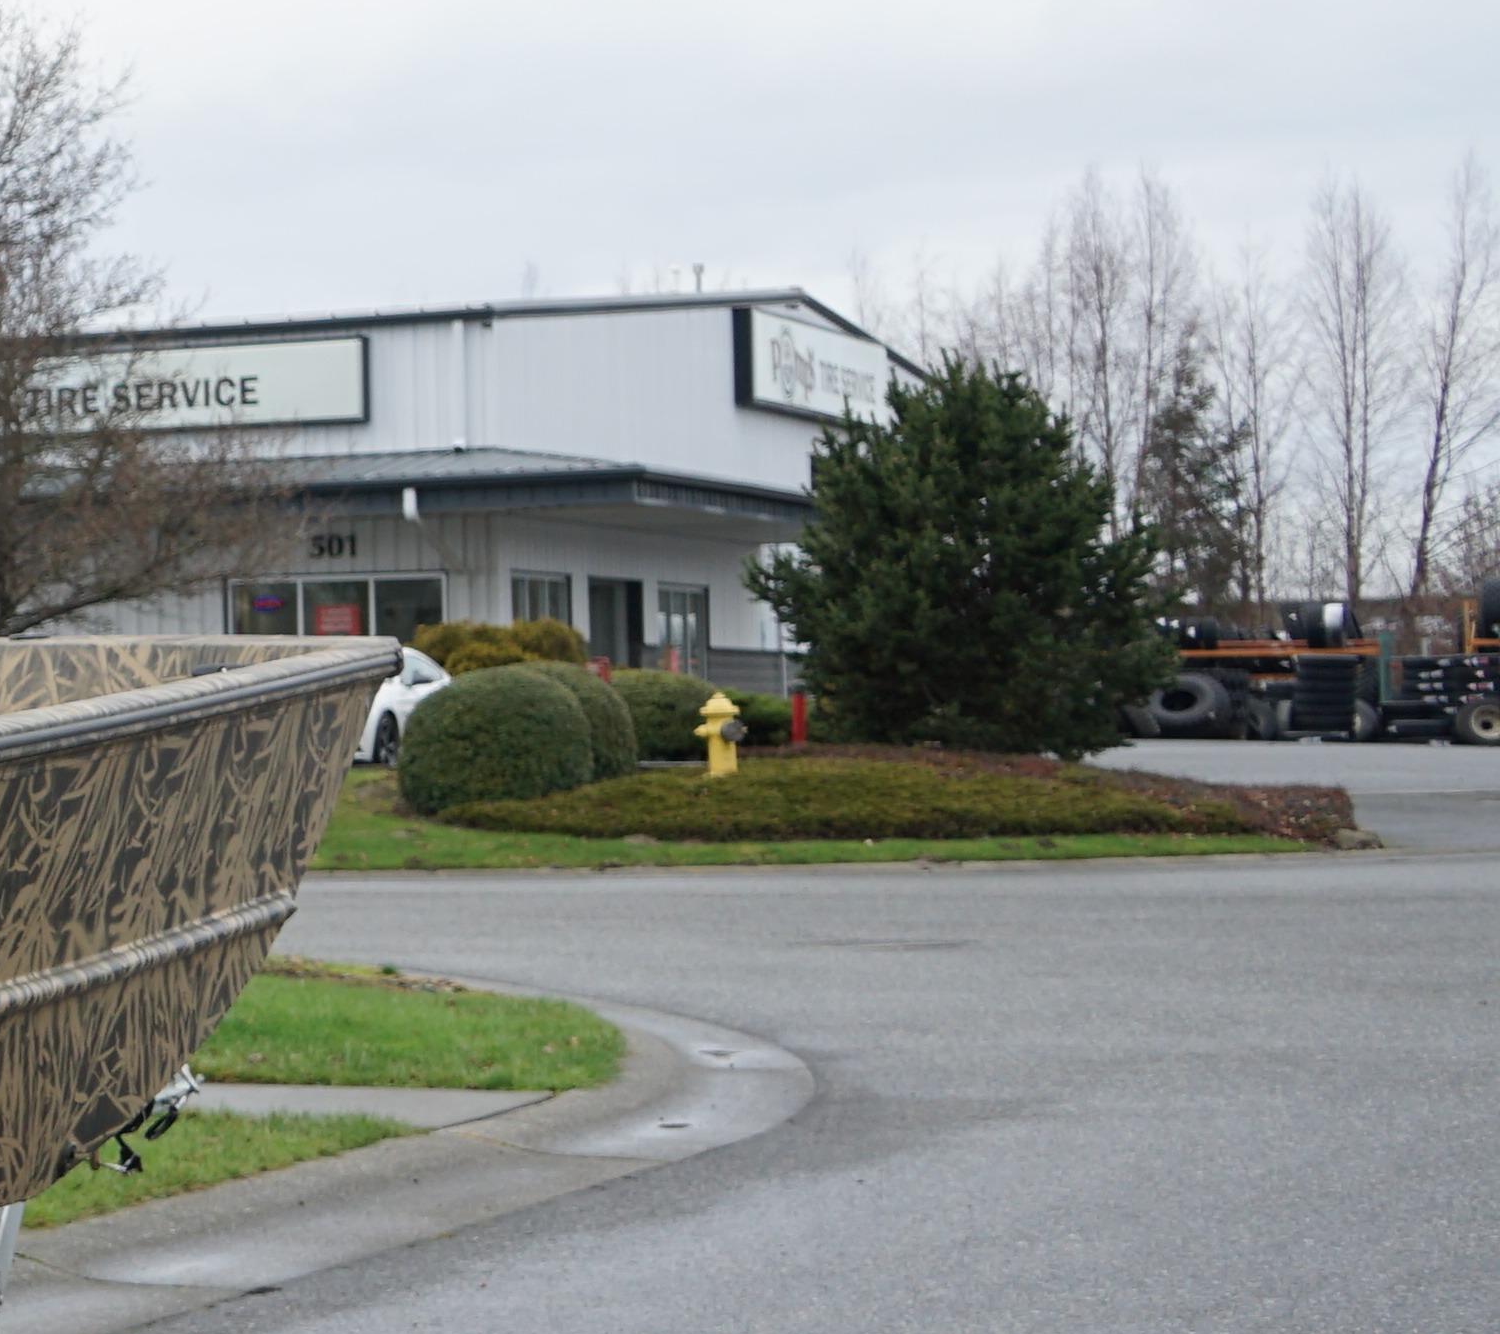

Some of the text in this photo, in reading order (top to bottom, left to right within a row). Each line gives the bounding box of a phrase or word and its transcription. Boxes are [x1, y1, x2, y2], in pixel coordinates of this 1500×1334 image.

[24, 375, 260, 420] TIRE SERVICE
[309, 533, 357, 559] 501
